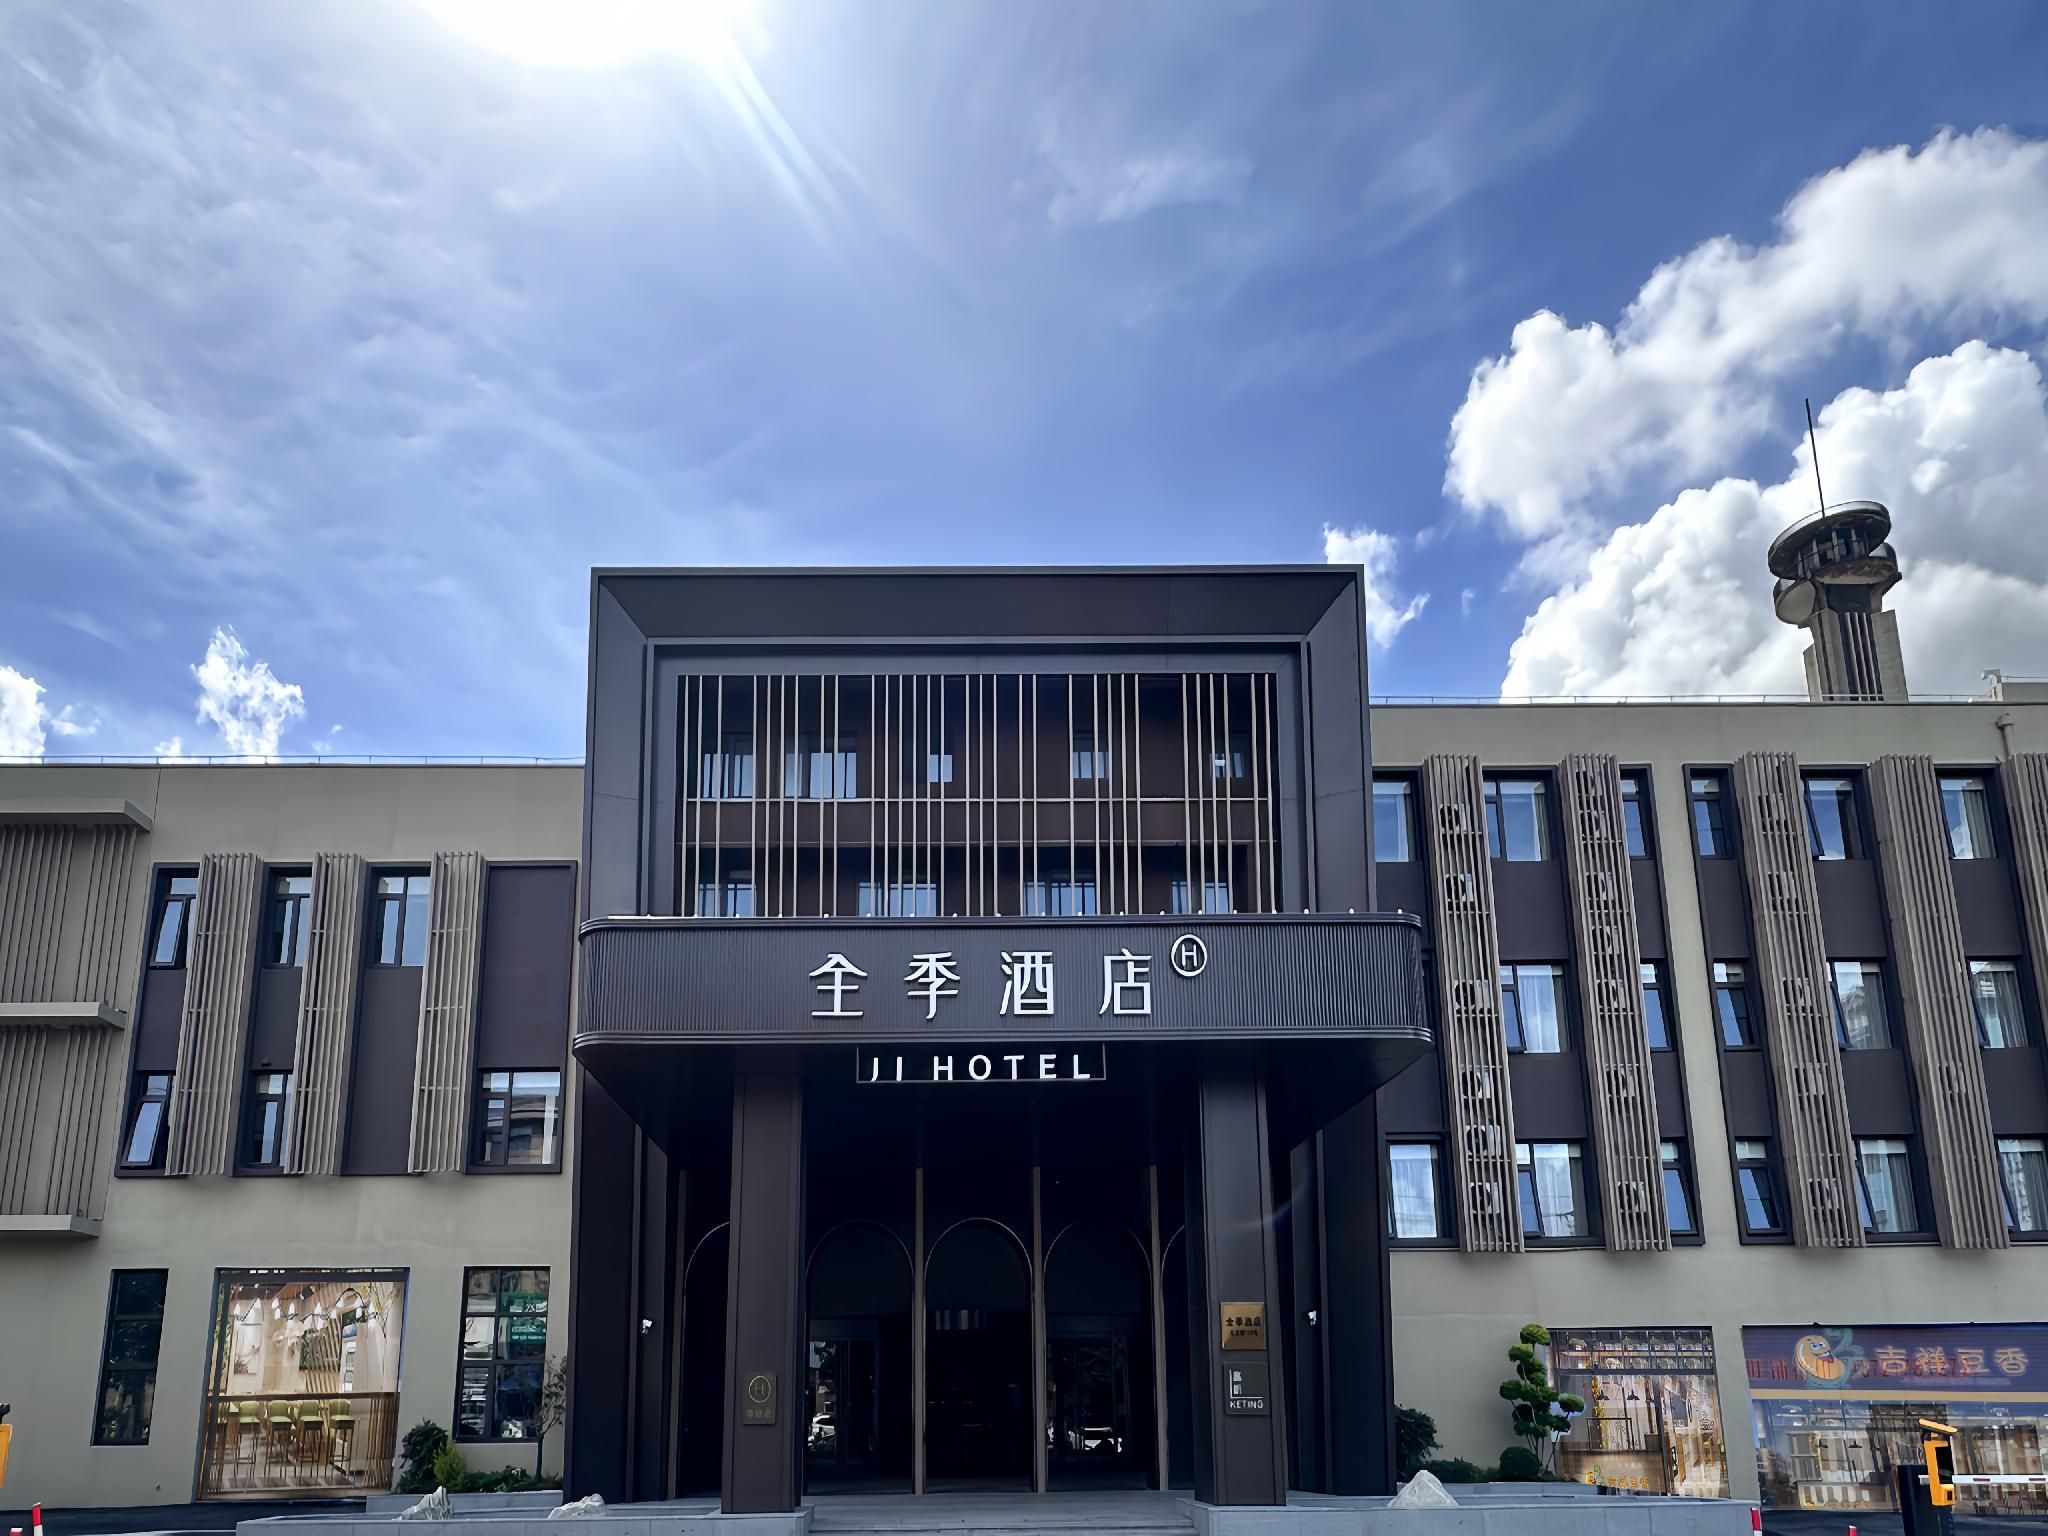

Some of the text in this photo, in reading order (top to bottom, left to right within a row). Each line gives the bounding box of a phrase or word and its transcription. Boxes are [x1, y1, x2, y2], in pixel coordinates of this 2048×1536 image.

[808, 948, 1152, 1019] 全季酒店
[871, 1054, 1091, 1082] JI HOTEL
[1230, 1400, 1264, 1409] KETING
